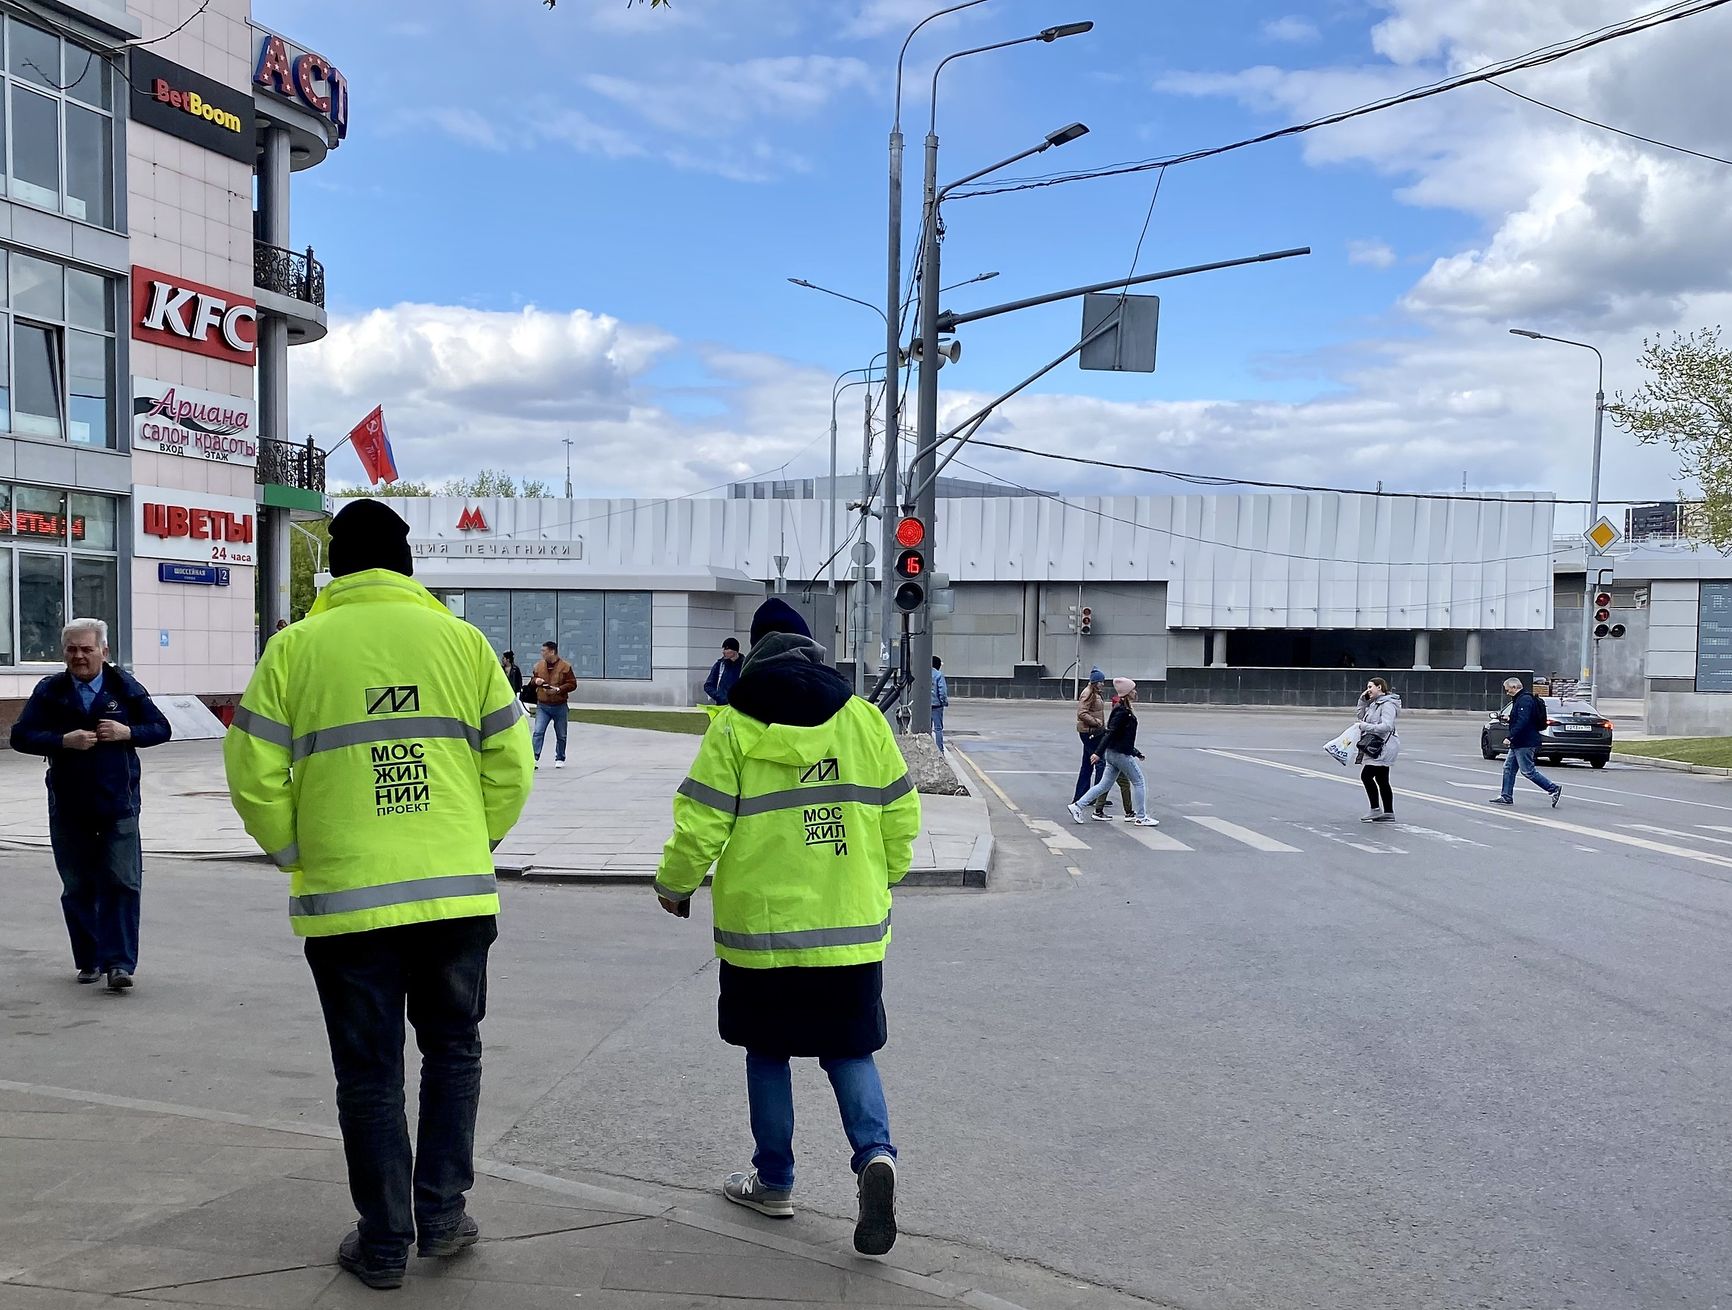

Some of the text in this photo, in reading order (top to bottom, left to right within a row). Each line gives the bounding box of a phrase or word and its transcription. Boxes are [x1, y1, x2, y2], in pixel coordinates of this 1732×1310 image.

[153, 78, 241, 133] BetBoom
[142, 280, 257, 352] KFC
[149, 388, 249, 429] Ариана
[142, 423, 256, 457] салон красоты
[159, 443, 229, 461] ВХОД ЭТАЖ
[143, 503, 253, 543] ЦВЕТЫ
[211, 547, 251, 562] 24 часа
[465, 544, 571, 555] ПЕЧАТНИКИ
[221, 570, 227, 580] 2
[907, 558, 919, 574] 16
[371, 743, 425, 762] МОС
[373, 764, 428, 785] ЖИЛ
[375, 785, 430, 805] НИИ
[377, 803, 430, 816] ПРОЕКТ
[803, 807, 843, 823] МОС
[805, 824, 846, 841] ЖИЛ
[835, 842, 848, 856] И
